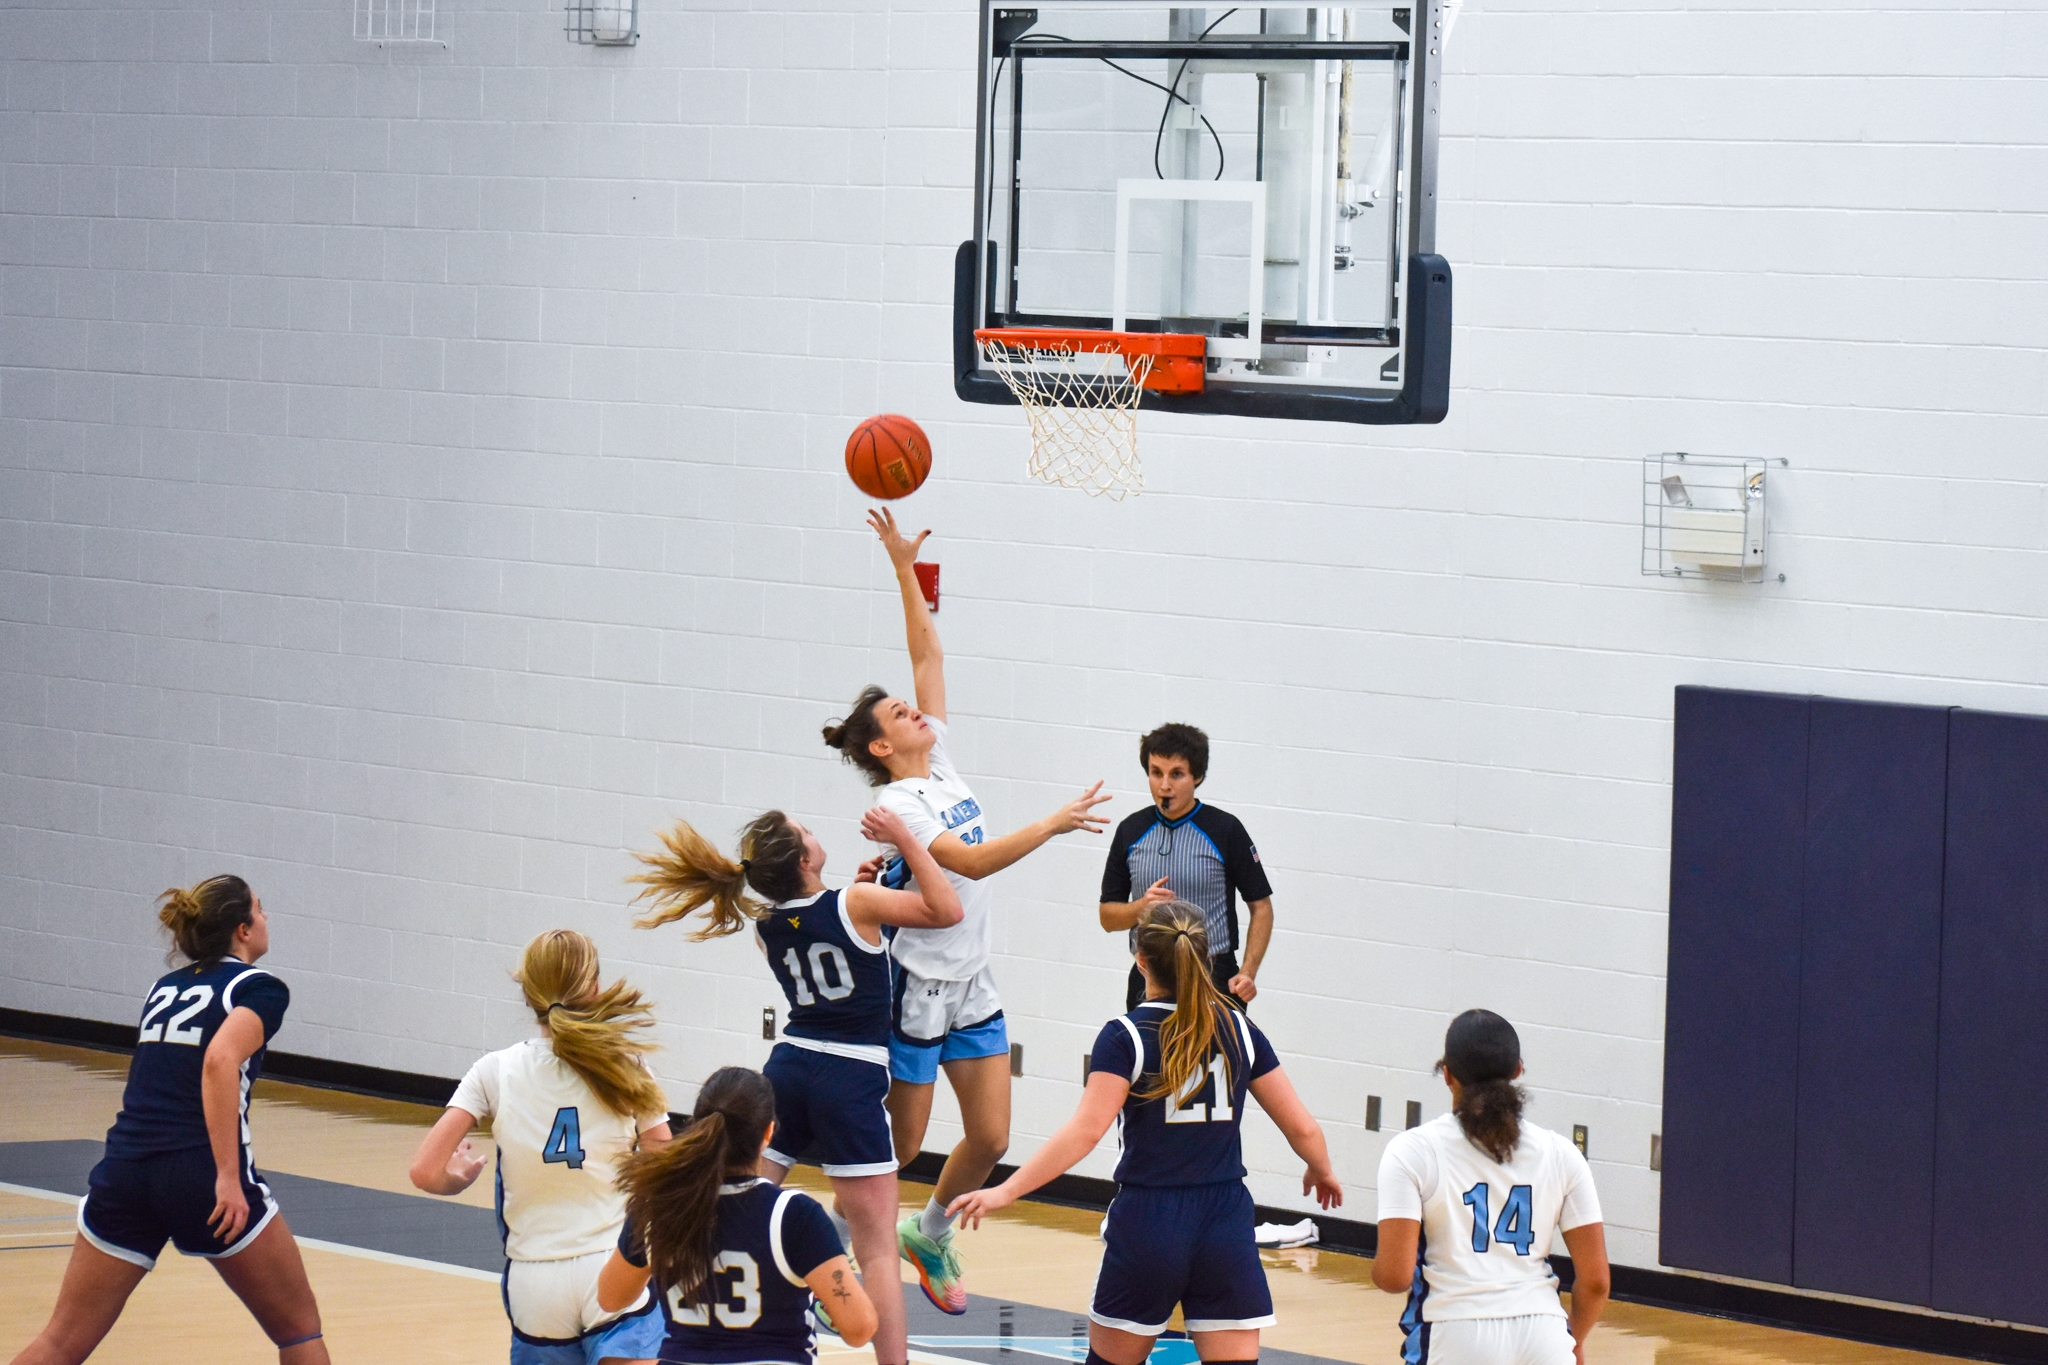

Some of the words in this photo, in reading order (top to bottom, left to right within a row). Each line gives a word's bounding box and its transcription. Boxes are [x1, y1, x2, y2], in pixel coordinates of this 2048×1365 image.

[782, 942, 855, 1006] 10
[138, 985, 214, 1046] 22
[1165, 1053, 1233, 1123] 21
[542, 1106, 586, 1170] 4
[1462, 1182, 1535, 1256] 14
